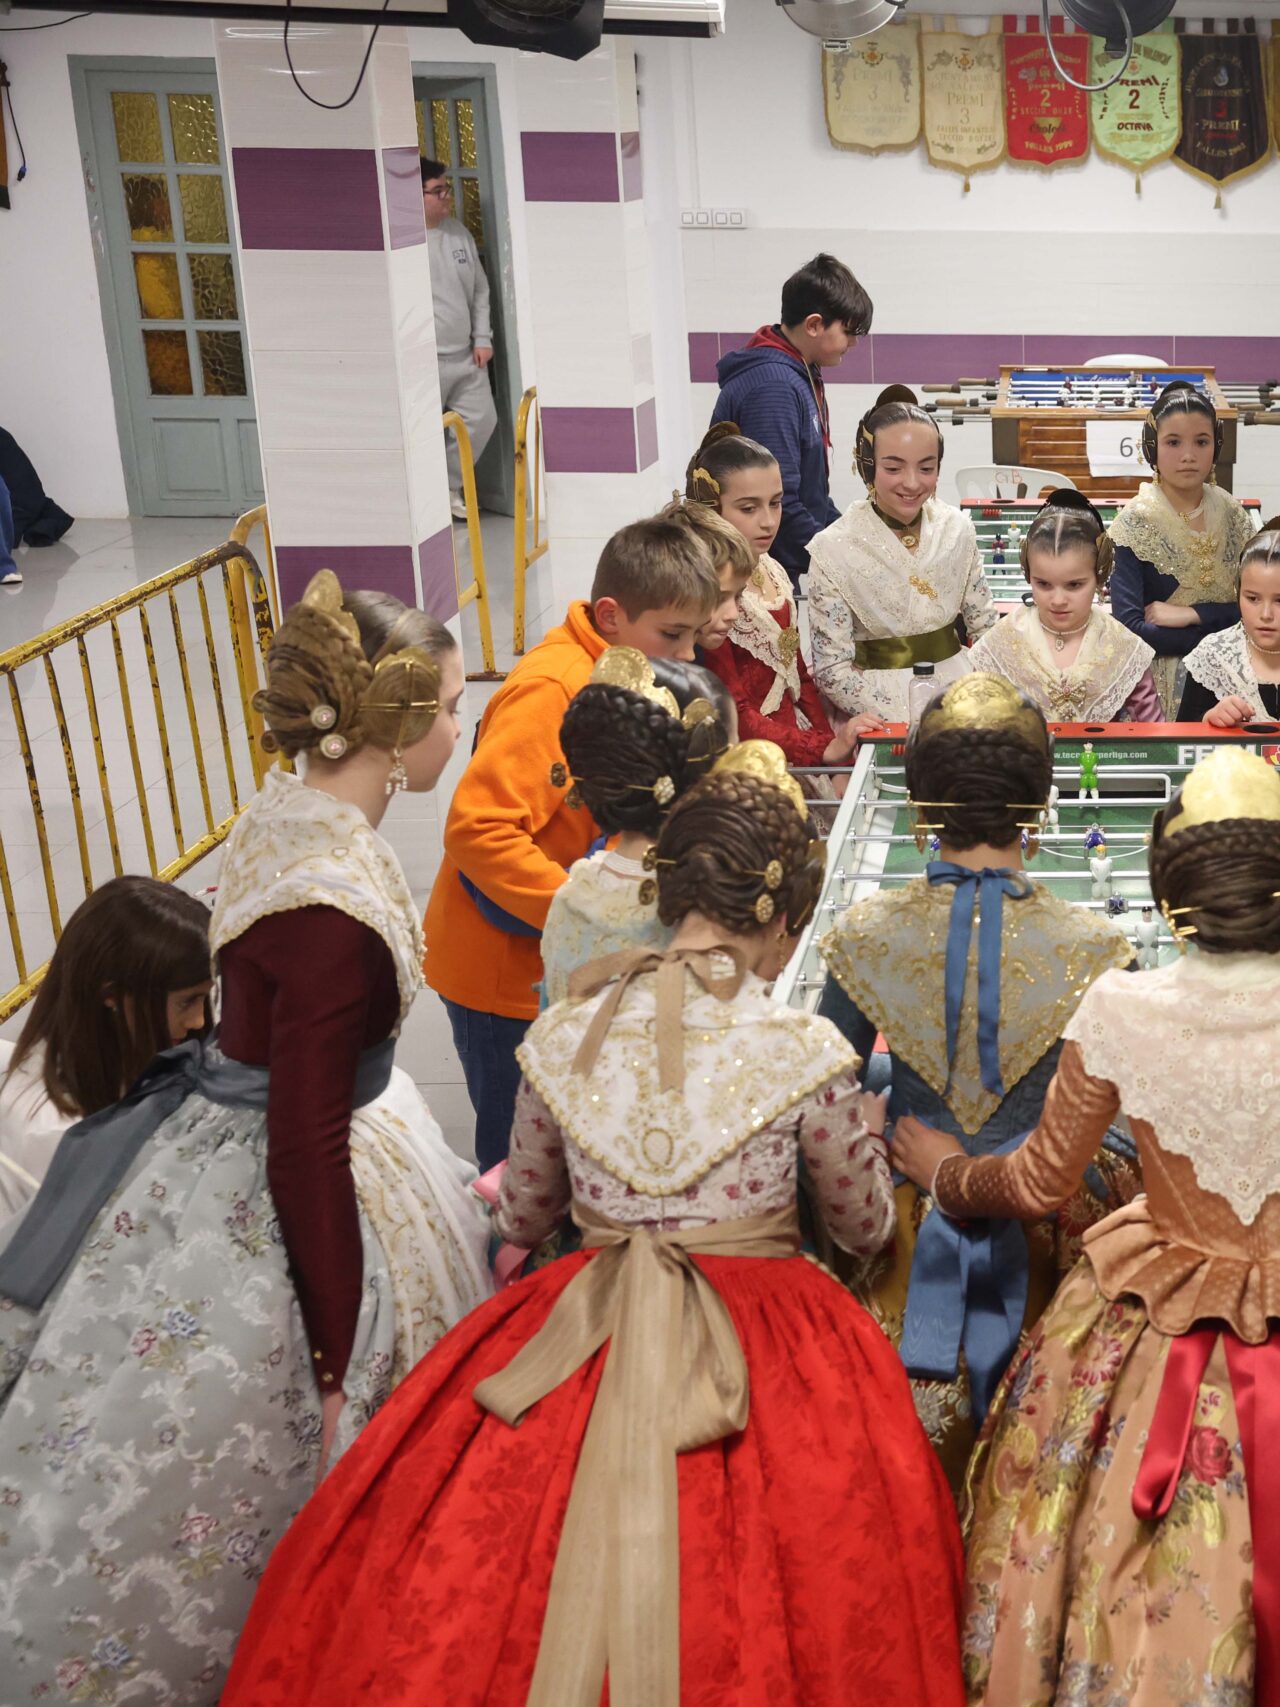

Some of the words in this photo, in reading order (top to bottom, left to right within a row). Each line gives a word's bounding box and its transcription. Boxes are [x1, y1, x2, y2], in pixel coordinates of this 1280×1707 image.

[947, 92, 984, 107] PREMI
[1040, 89, 1051, 107] 2
[1129, 89, 1140, 109] 2
[960, 107, 971, 125] 3
[1117, 122, 1153, 132] OCTAVA
[1119, 437, 1133, 457] 6
